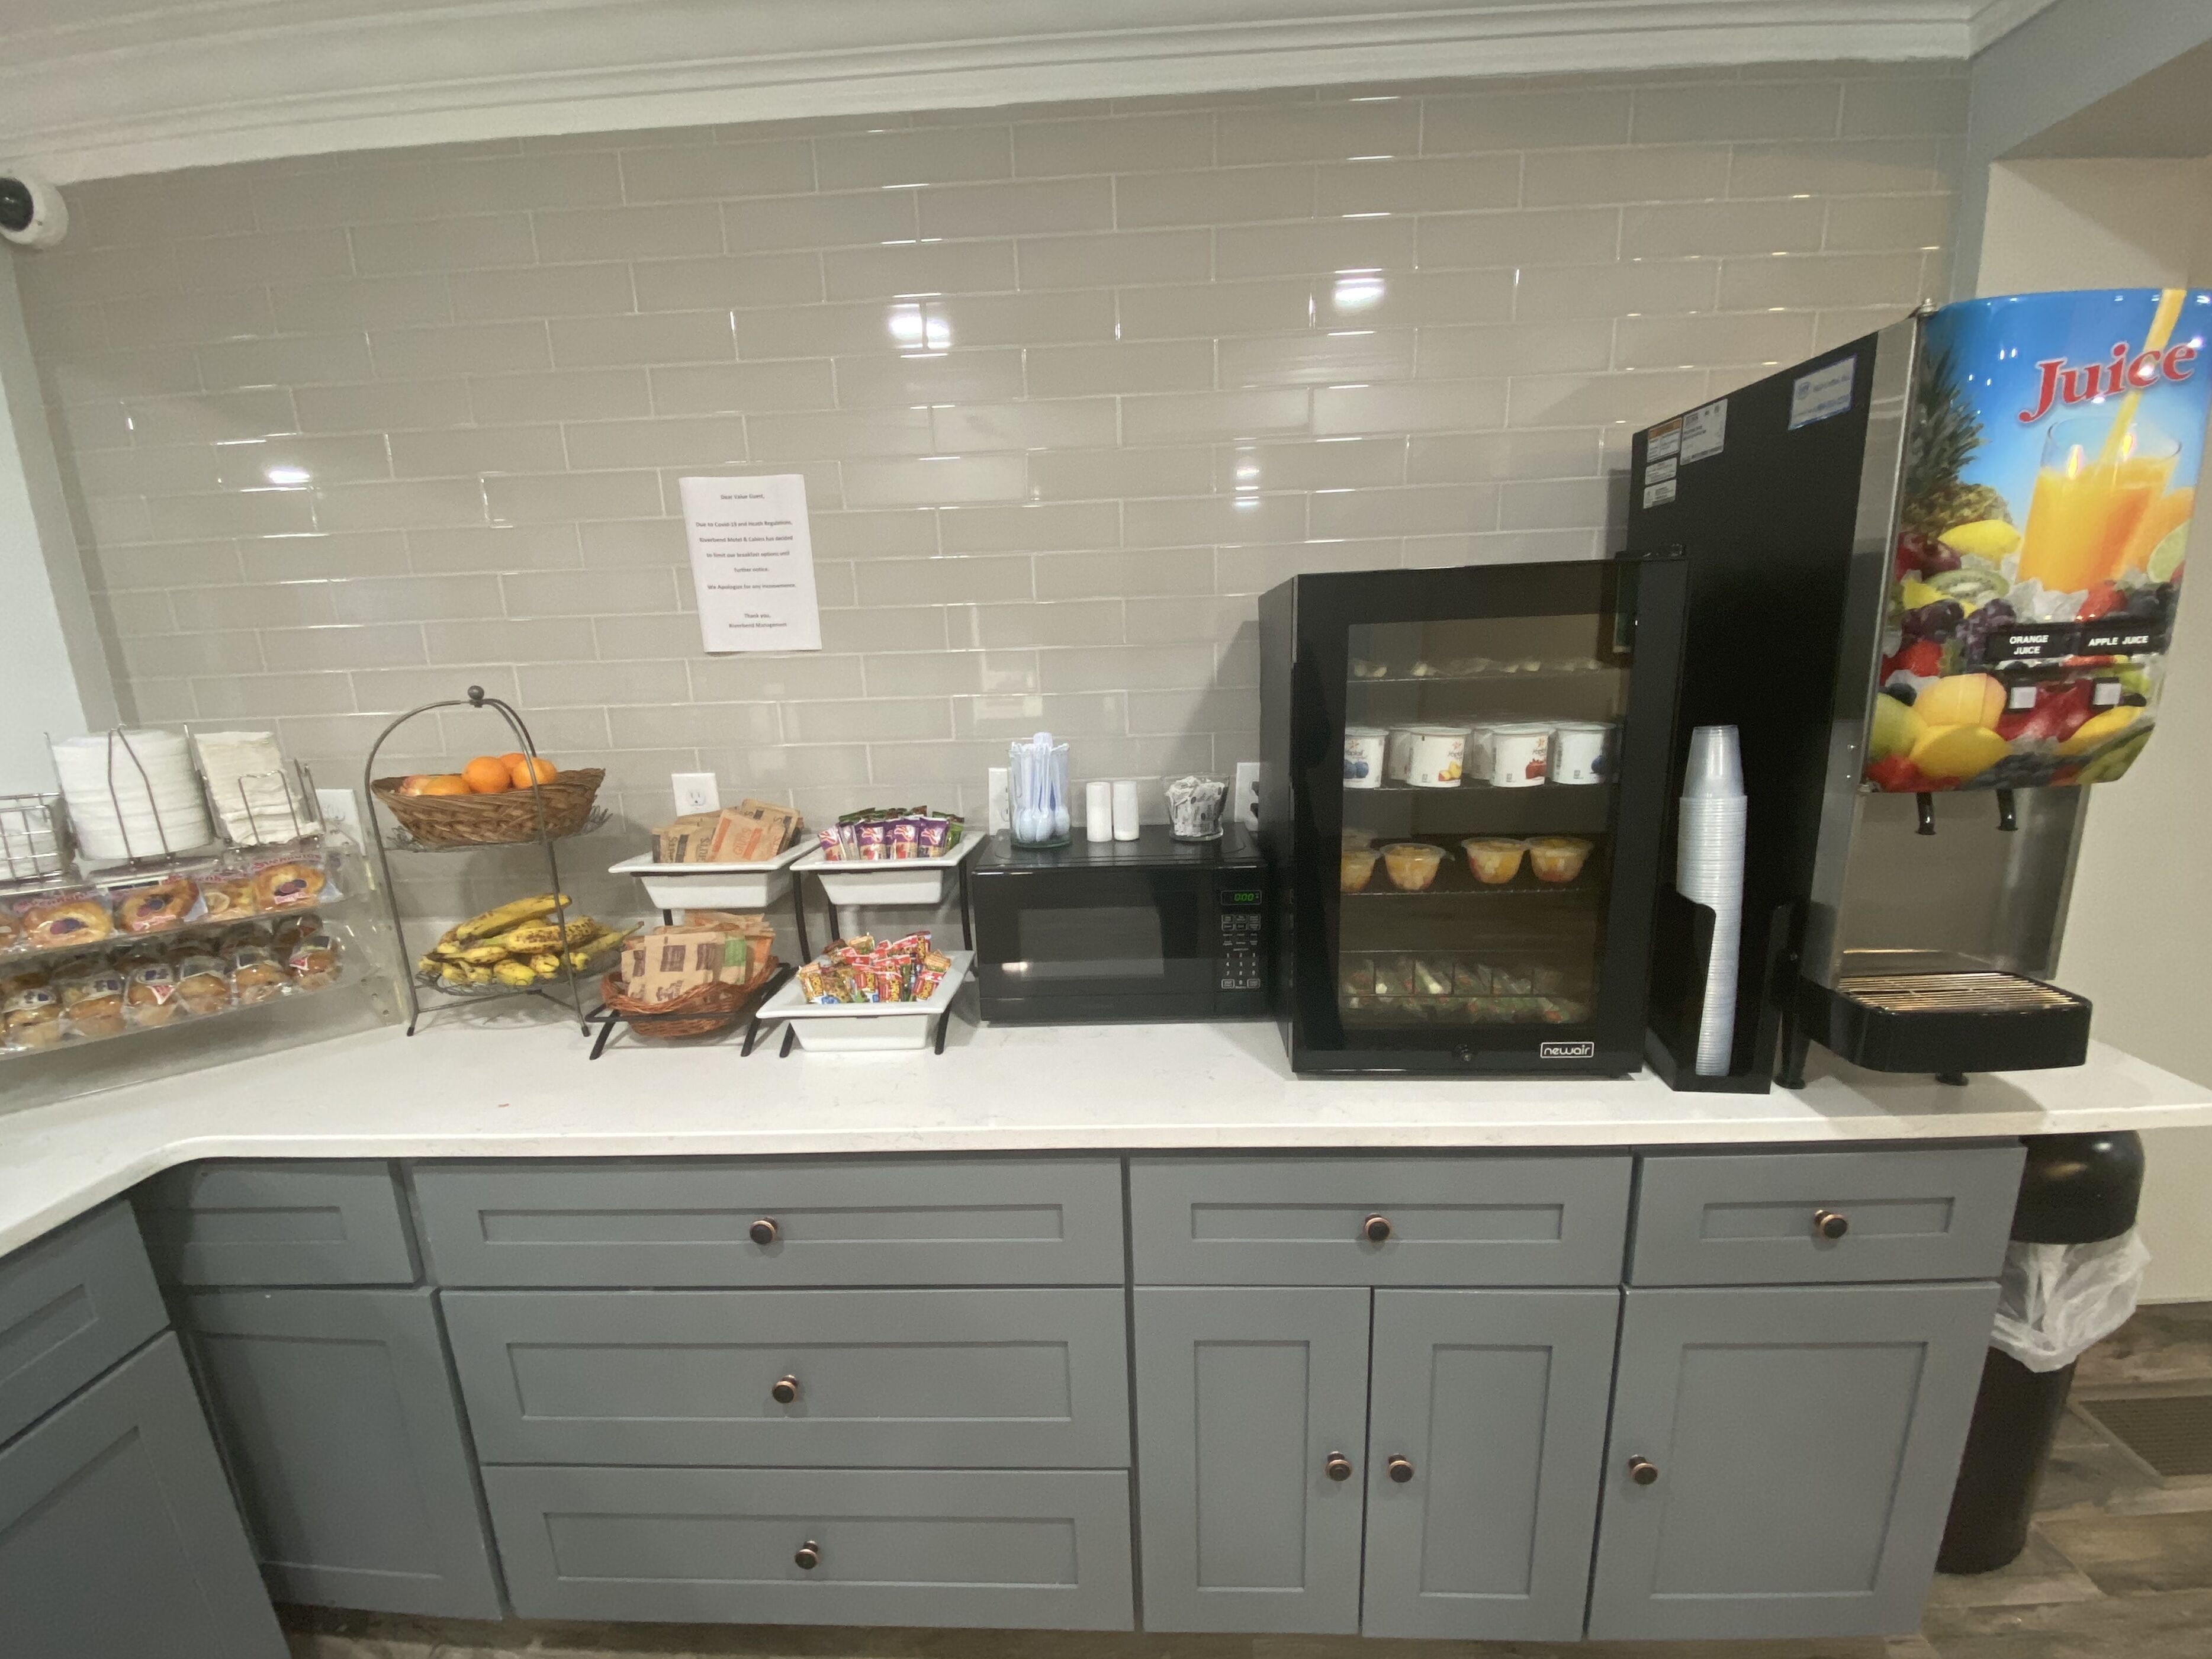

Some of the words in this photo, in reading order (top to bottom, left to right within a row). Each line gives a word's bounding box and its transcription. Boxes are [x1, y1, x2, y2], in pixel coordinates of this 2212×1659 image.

[2018, 341, 2197, 423] Juice
[2009, 634, 2049, 645] ORANGE
[2088, 637, 2118, 647] APPLE
[2122, 635, 2149, 645] JUICE
[2013, 646, 2040, 655] JUICE
[1544, 1044, 1590, 1055] newair
